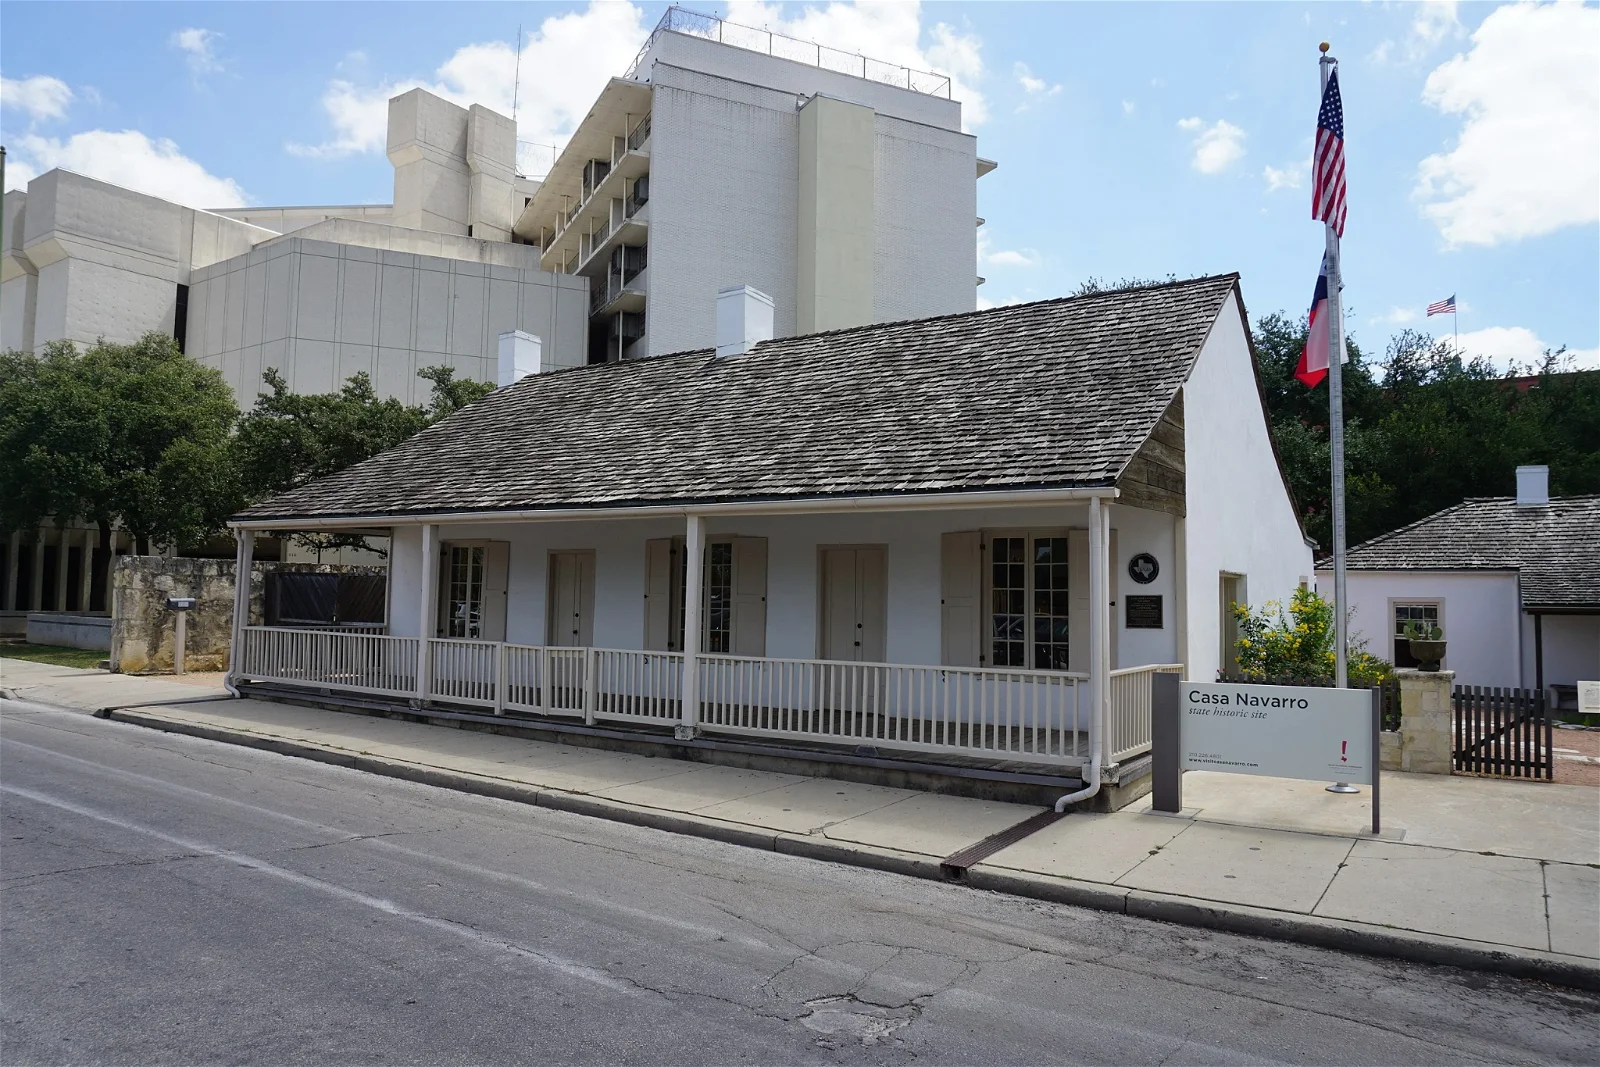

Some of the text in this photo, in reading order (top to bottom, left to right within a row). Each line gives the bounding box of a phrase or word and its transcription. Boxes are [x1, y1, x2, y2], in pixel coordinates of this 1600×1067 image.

[1189, 690, 1308, 709] Casa Navarro
[1189, 707, 1268, 719] state historic site
